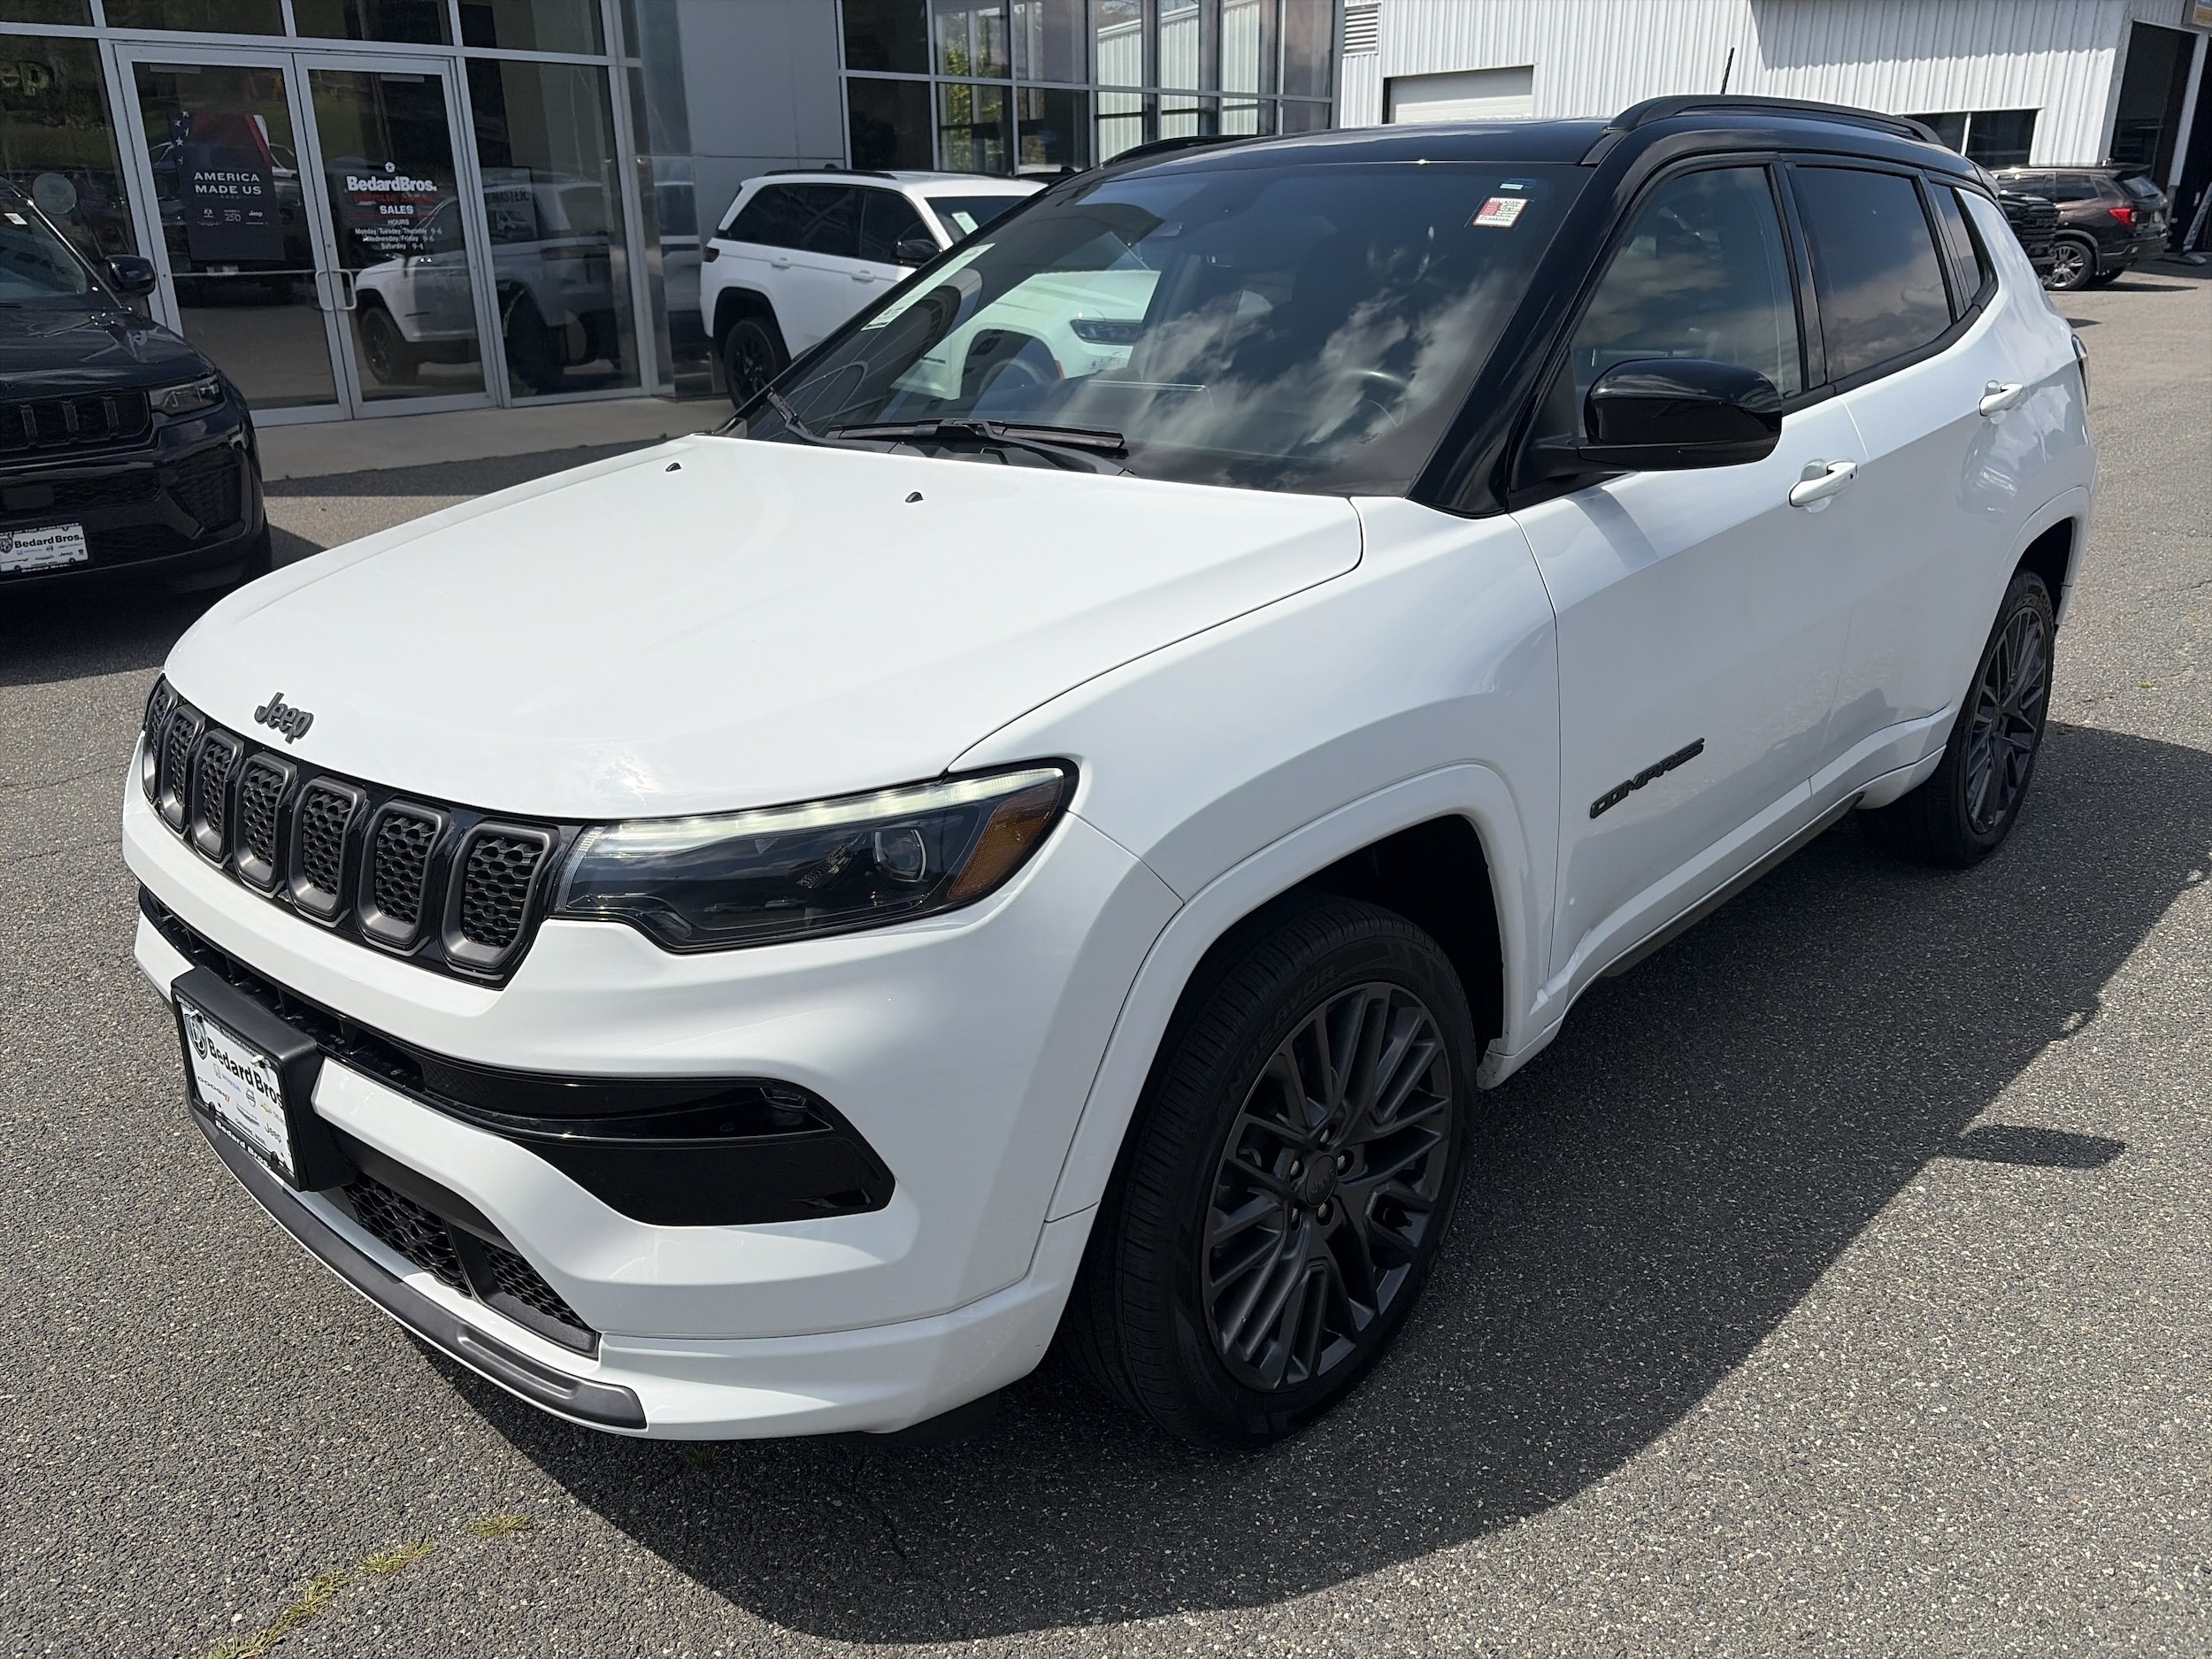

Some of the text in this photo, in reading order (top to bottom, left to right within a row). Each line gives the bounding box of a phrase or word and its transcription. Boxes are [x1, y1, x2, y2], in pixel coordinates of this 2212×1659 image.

[194, 172, 260, 182] AMERICA
[195, 185, 262, 195] MADE US
[379, 204, 414, 214] SALES
[254, 692, 314, 745] Jeep
[1590, 737, 1705, 819] COMPASS
[264, 1122, 282, 1143] Jeep
[215, 1118, 246, 1148] Bedard
[247, 1145, 272, 1169] Bros.
